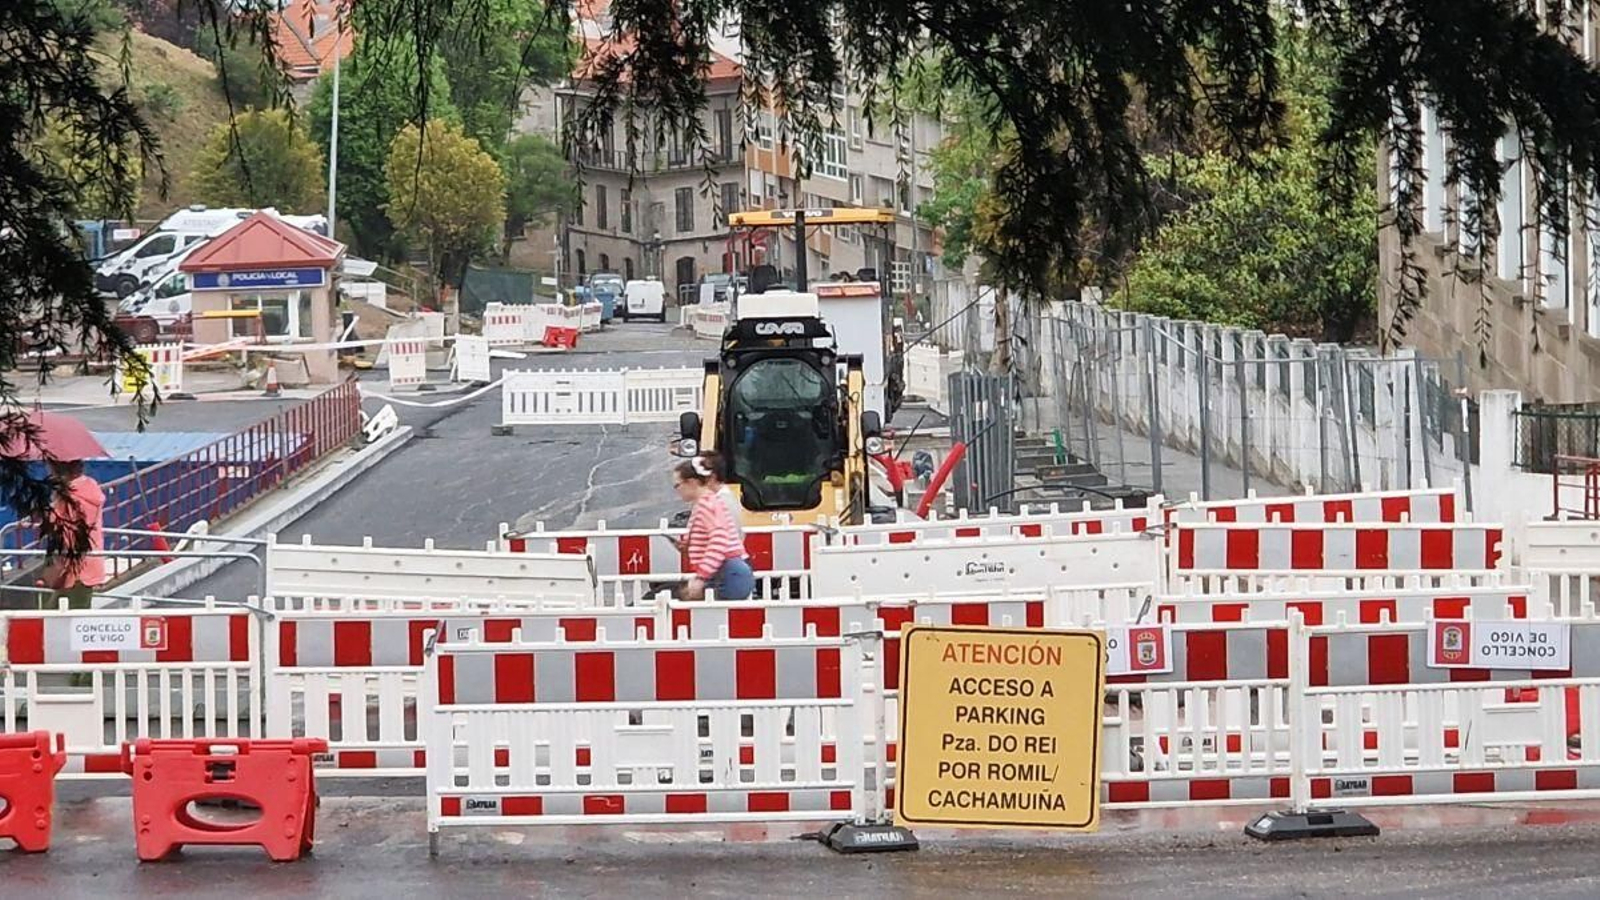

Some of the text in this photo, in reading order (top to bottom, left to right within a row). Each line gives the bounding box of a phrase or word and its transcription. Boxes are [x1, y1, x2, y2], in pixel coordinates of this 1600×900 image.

[271, 271, 298, 279] LOCAL
[75, 624, 132, 633] CONCELLO
[82, 633, 126, 643] DE VIGO
[1490, 631, 1548, 644] DE VIGO
[942, 639, 1062, 666] ATENCIÓN
[1481, 645, 1556, 657] CONCELLO
[948, 677, 1054, 698] ACCESO A
[955, 706, 1045, 726] PARKING
[942, 733, 1057, 754] Pza. DO REI
[938, 761, 1060, 784] POR ROMIL/
[928, 788, 1067, 811] CACHAMUIÑA
